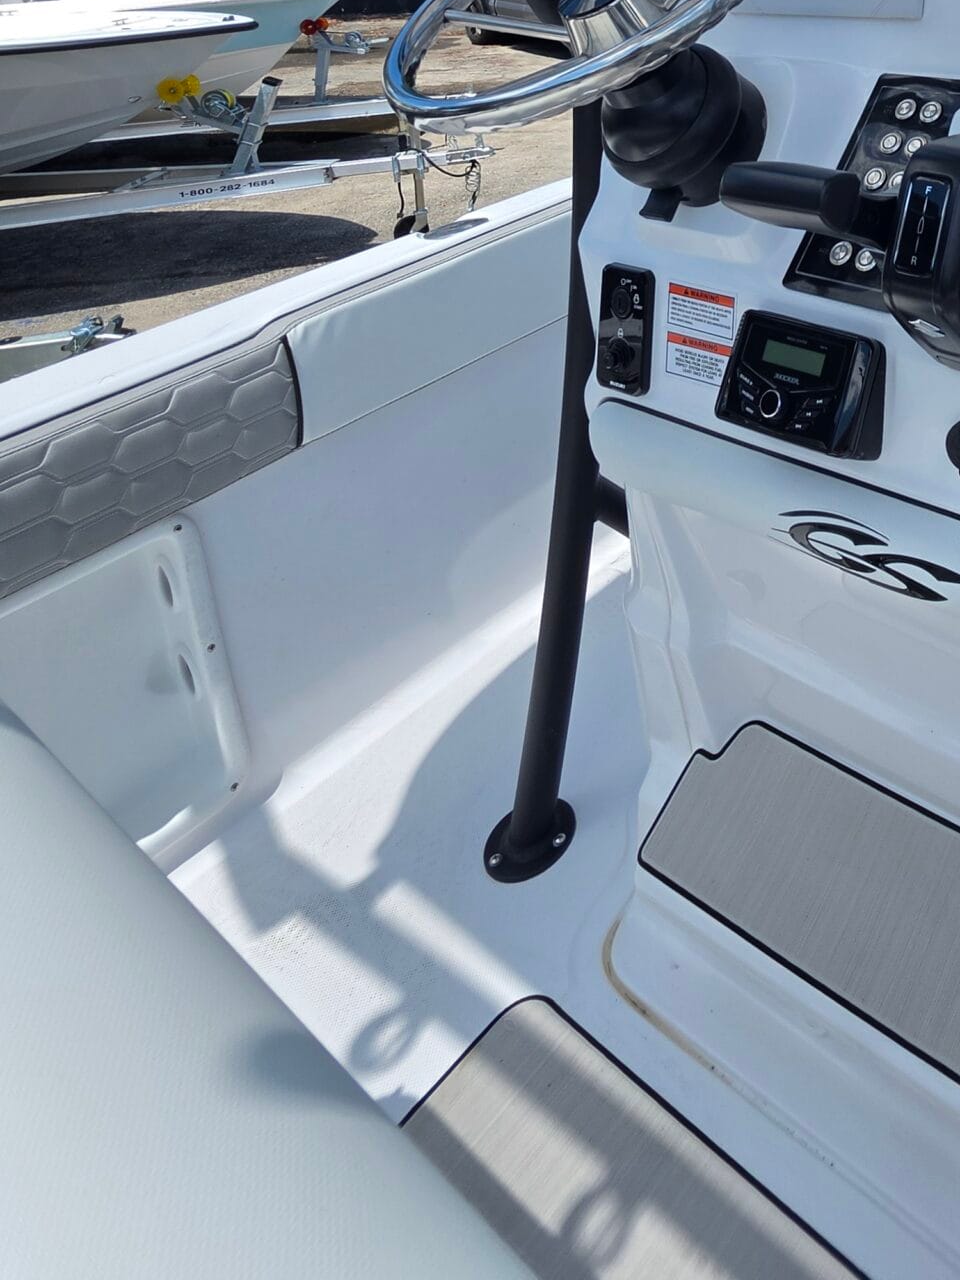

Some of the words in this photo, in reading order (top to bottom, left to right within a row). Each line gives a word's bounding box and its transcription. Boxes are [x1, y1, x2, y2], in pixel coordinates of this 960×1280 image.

[179, 179, 275, 198] 1-800-282-1684
[925, 185, 932, 195] F
[911, 256, 918, 265] R
[690, 289, 720, 303] WARNING
